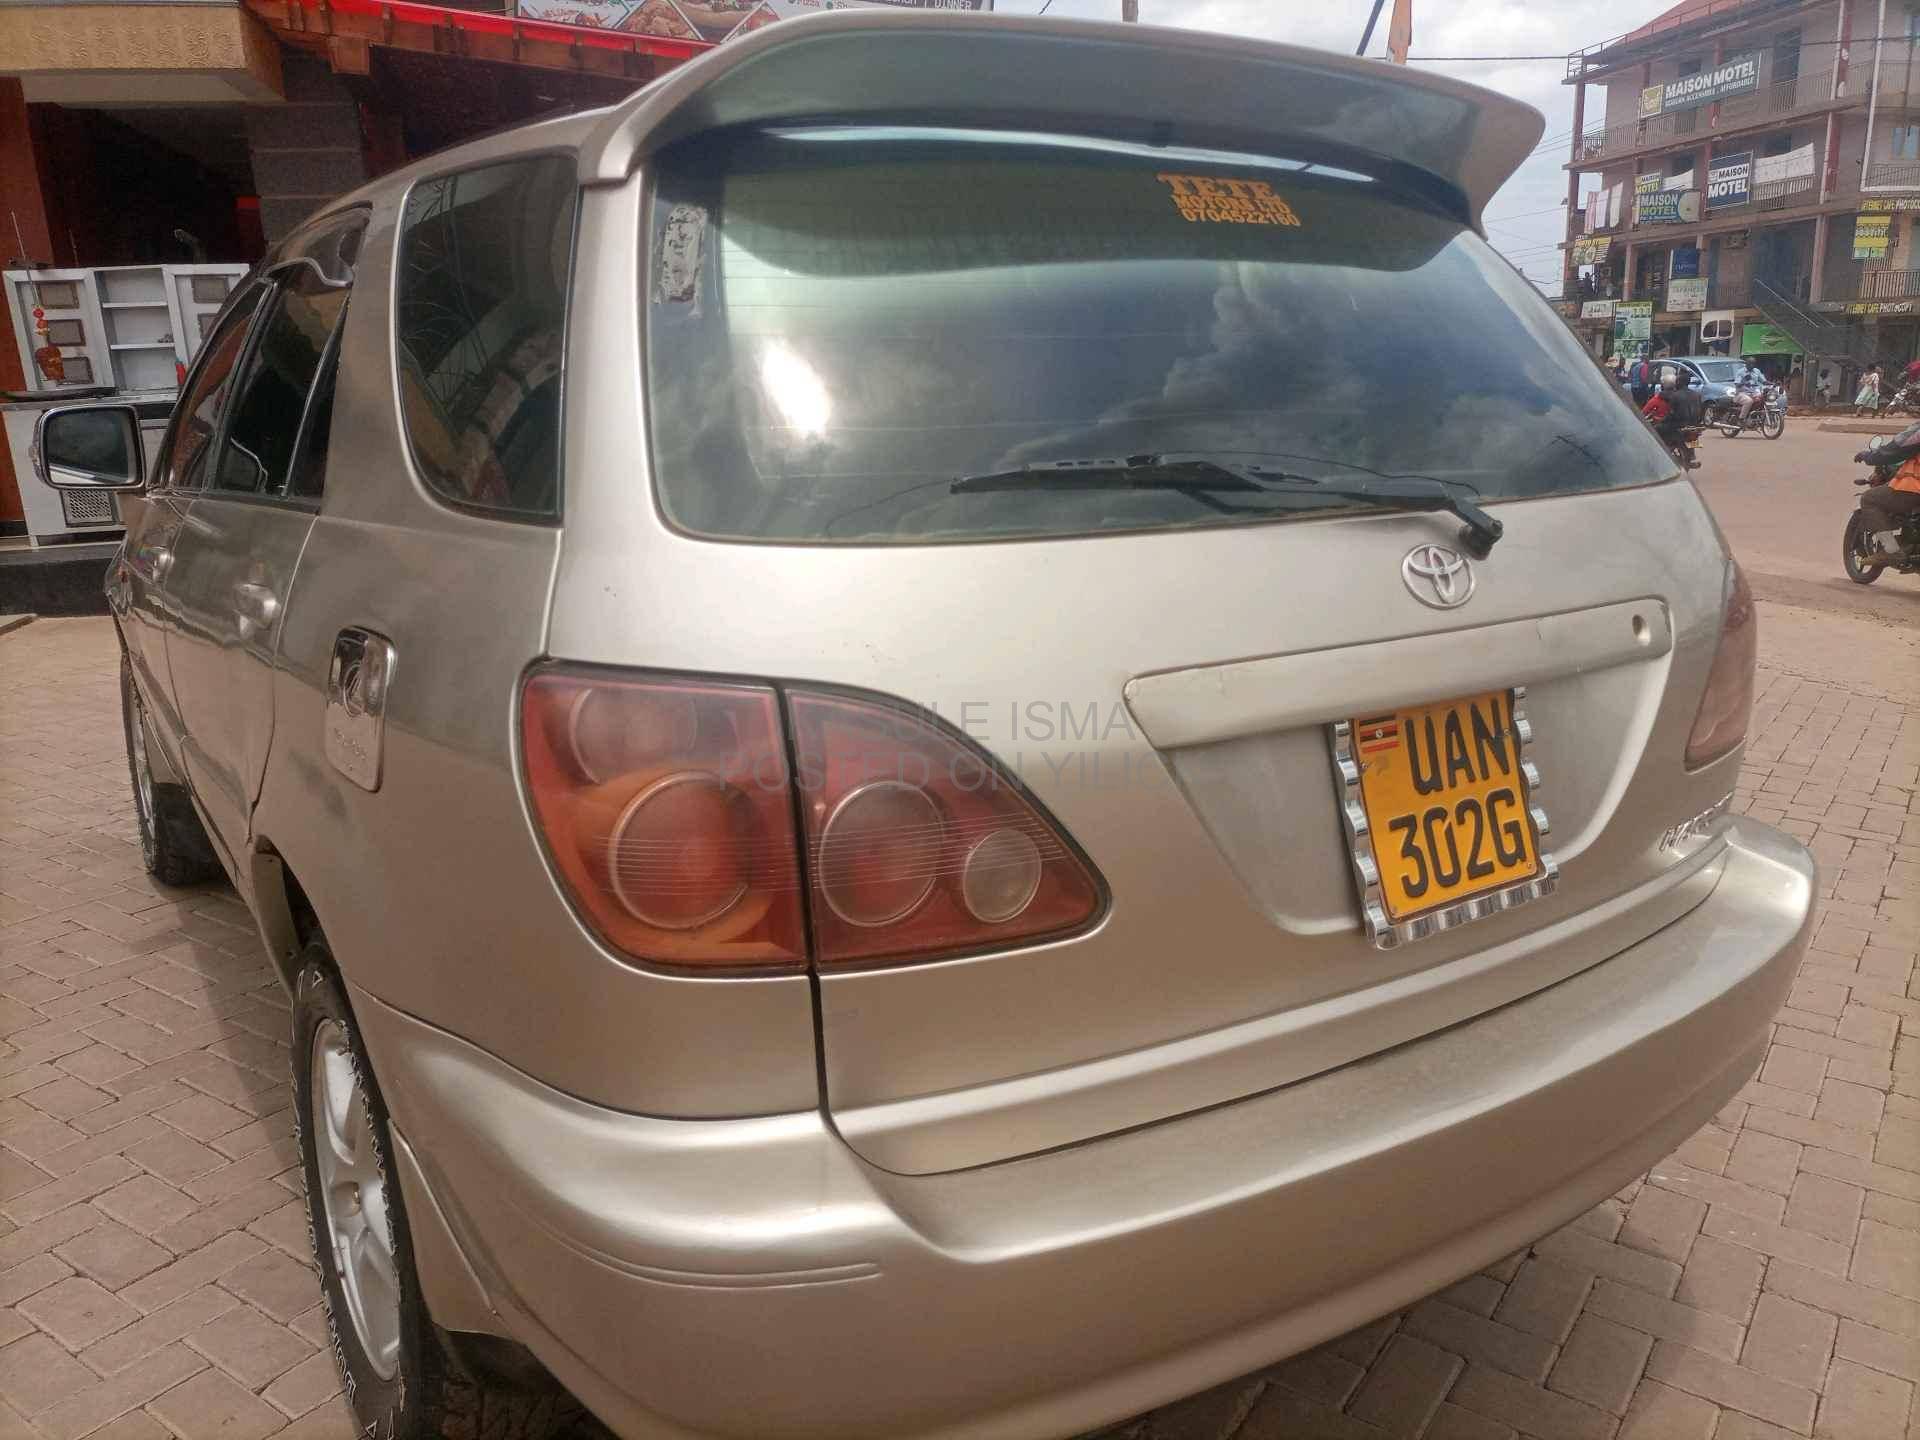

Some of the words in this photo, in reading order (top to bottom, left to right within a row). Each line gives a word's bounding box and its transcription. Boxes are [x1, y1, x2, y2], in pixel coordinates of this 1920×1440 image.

[1666, 73, 1712, 99] MAISON
[1713, 61, 1755, 86] MOTEL
[1719, 165, 1749, 179] MAISON
[1708, 178, 1747, 198] MOTEL
[1641, 194, 1678, 207] MAISON
[1641, 206, 1677, 216] MOTEL
[1404, 698, 1510, 796] UAN
[1389, 787, 1528, 898] 302G
